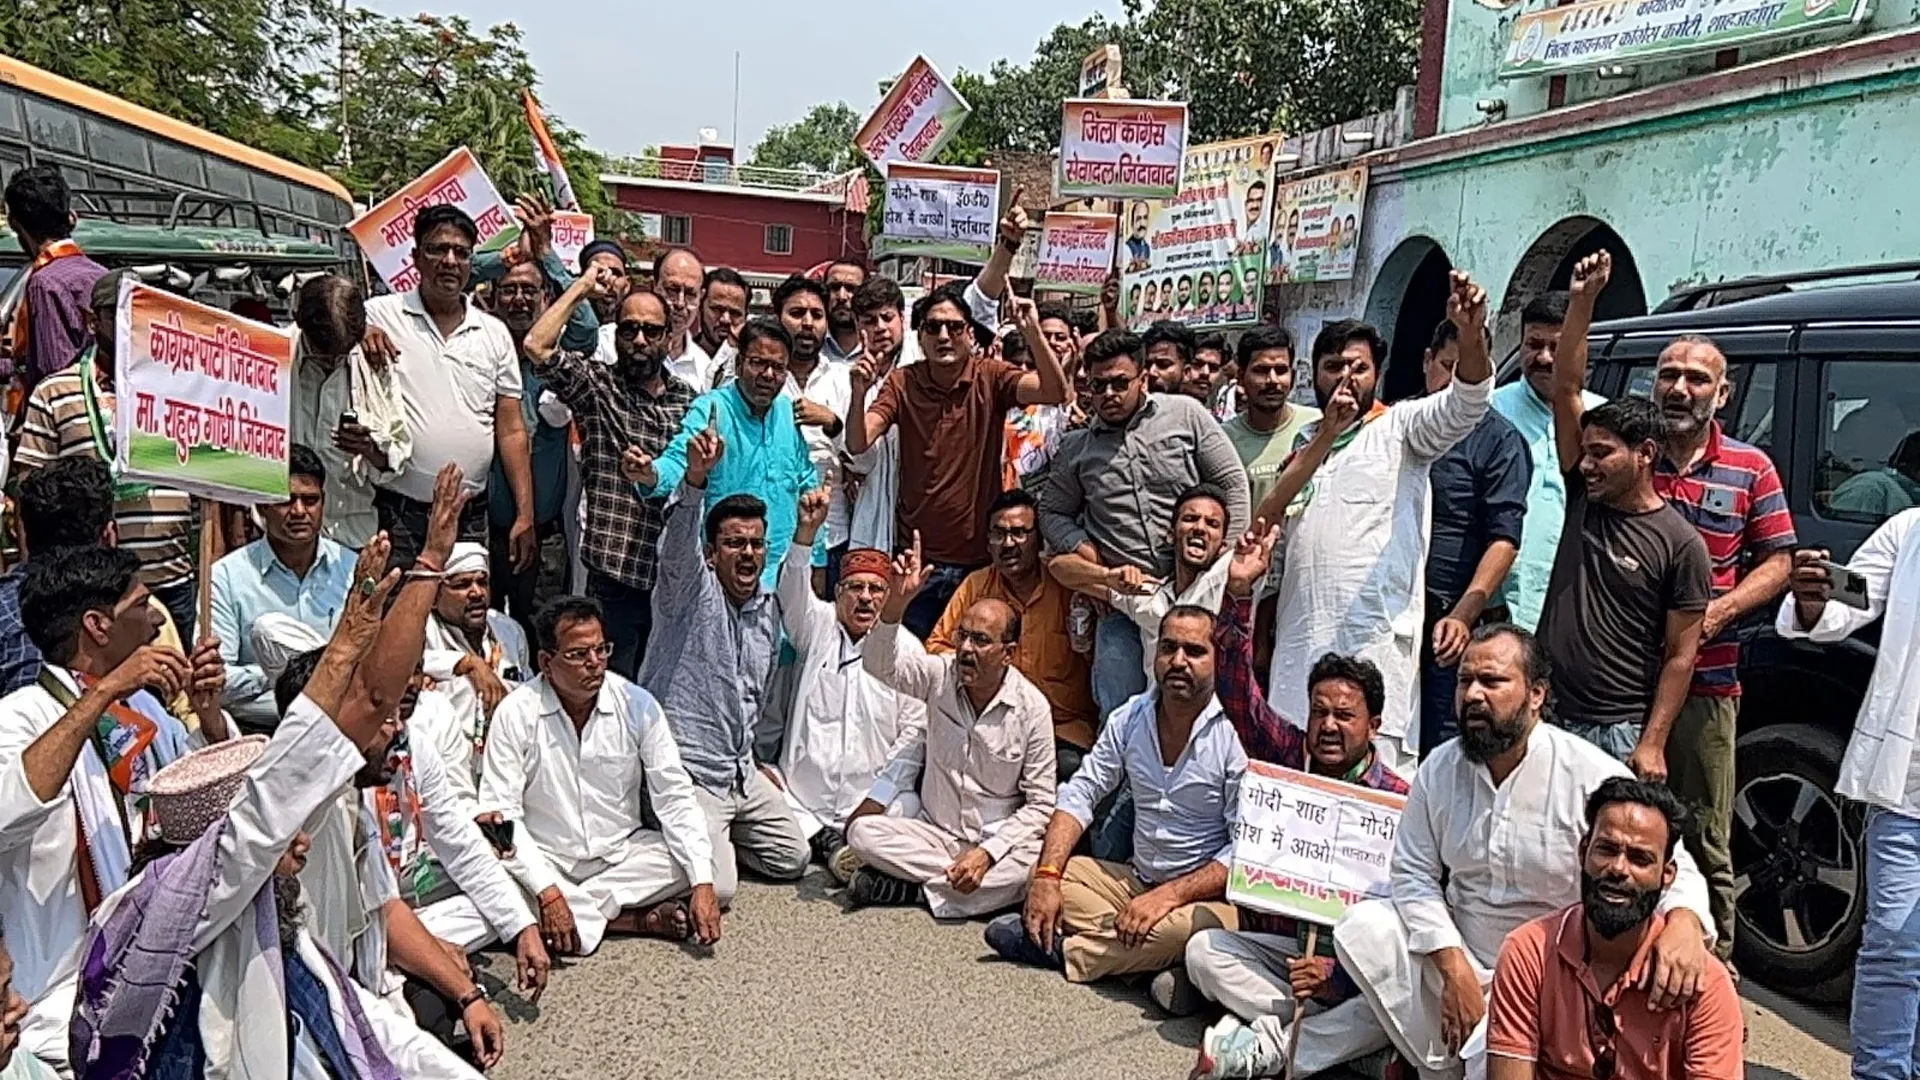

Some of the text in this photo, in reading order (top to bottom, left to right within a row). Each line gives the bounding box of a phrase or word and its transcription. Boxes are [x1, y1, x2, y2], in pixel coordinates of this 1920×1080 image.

[1121, 112, 1167, 148] कांग्रेस
[885, 208, 944, 226] होश में आओ
[150, 312, 196, 376] कांग्रेस
[198, 326, 225, 380] पार्टी
[136, 392, 159, 434] मा.
[163, 398, 201, 464] राहुल
[203, 397, 236, 450] गांधी
[1231, 815, 1331, 864] होश में आओ
[1360, 810, 1395, 840] मोदी
